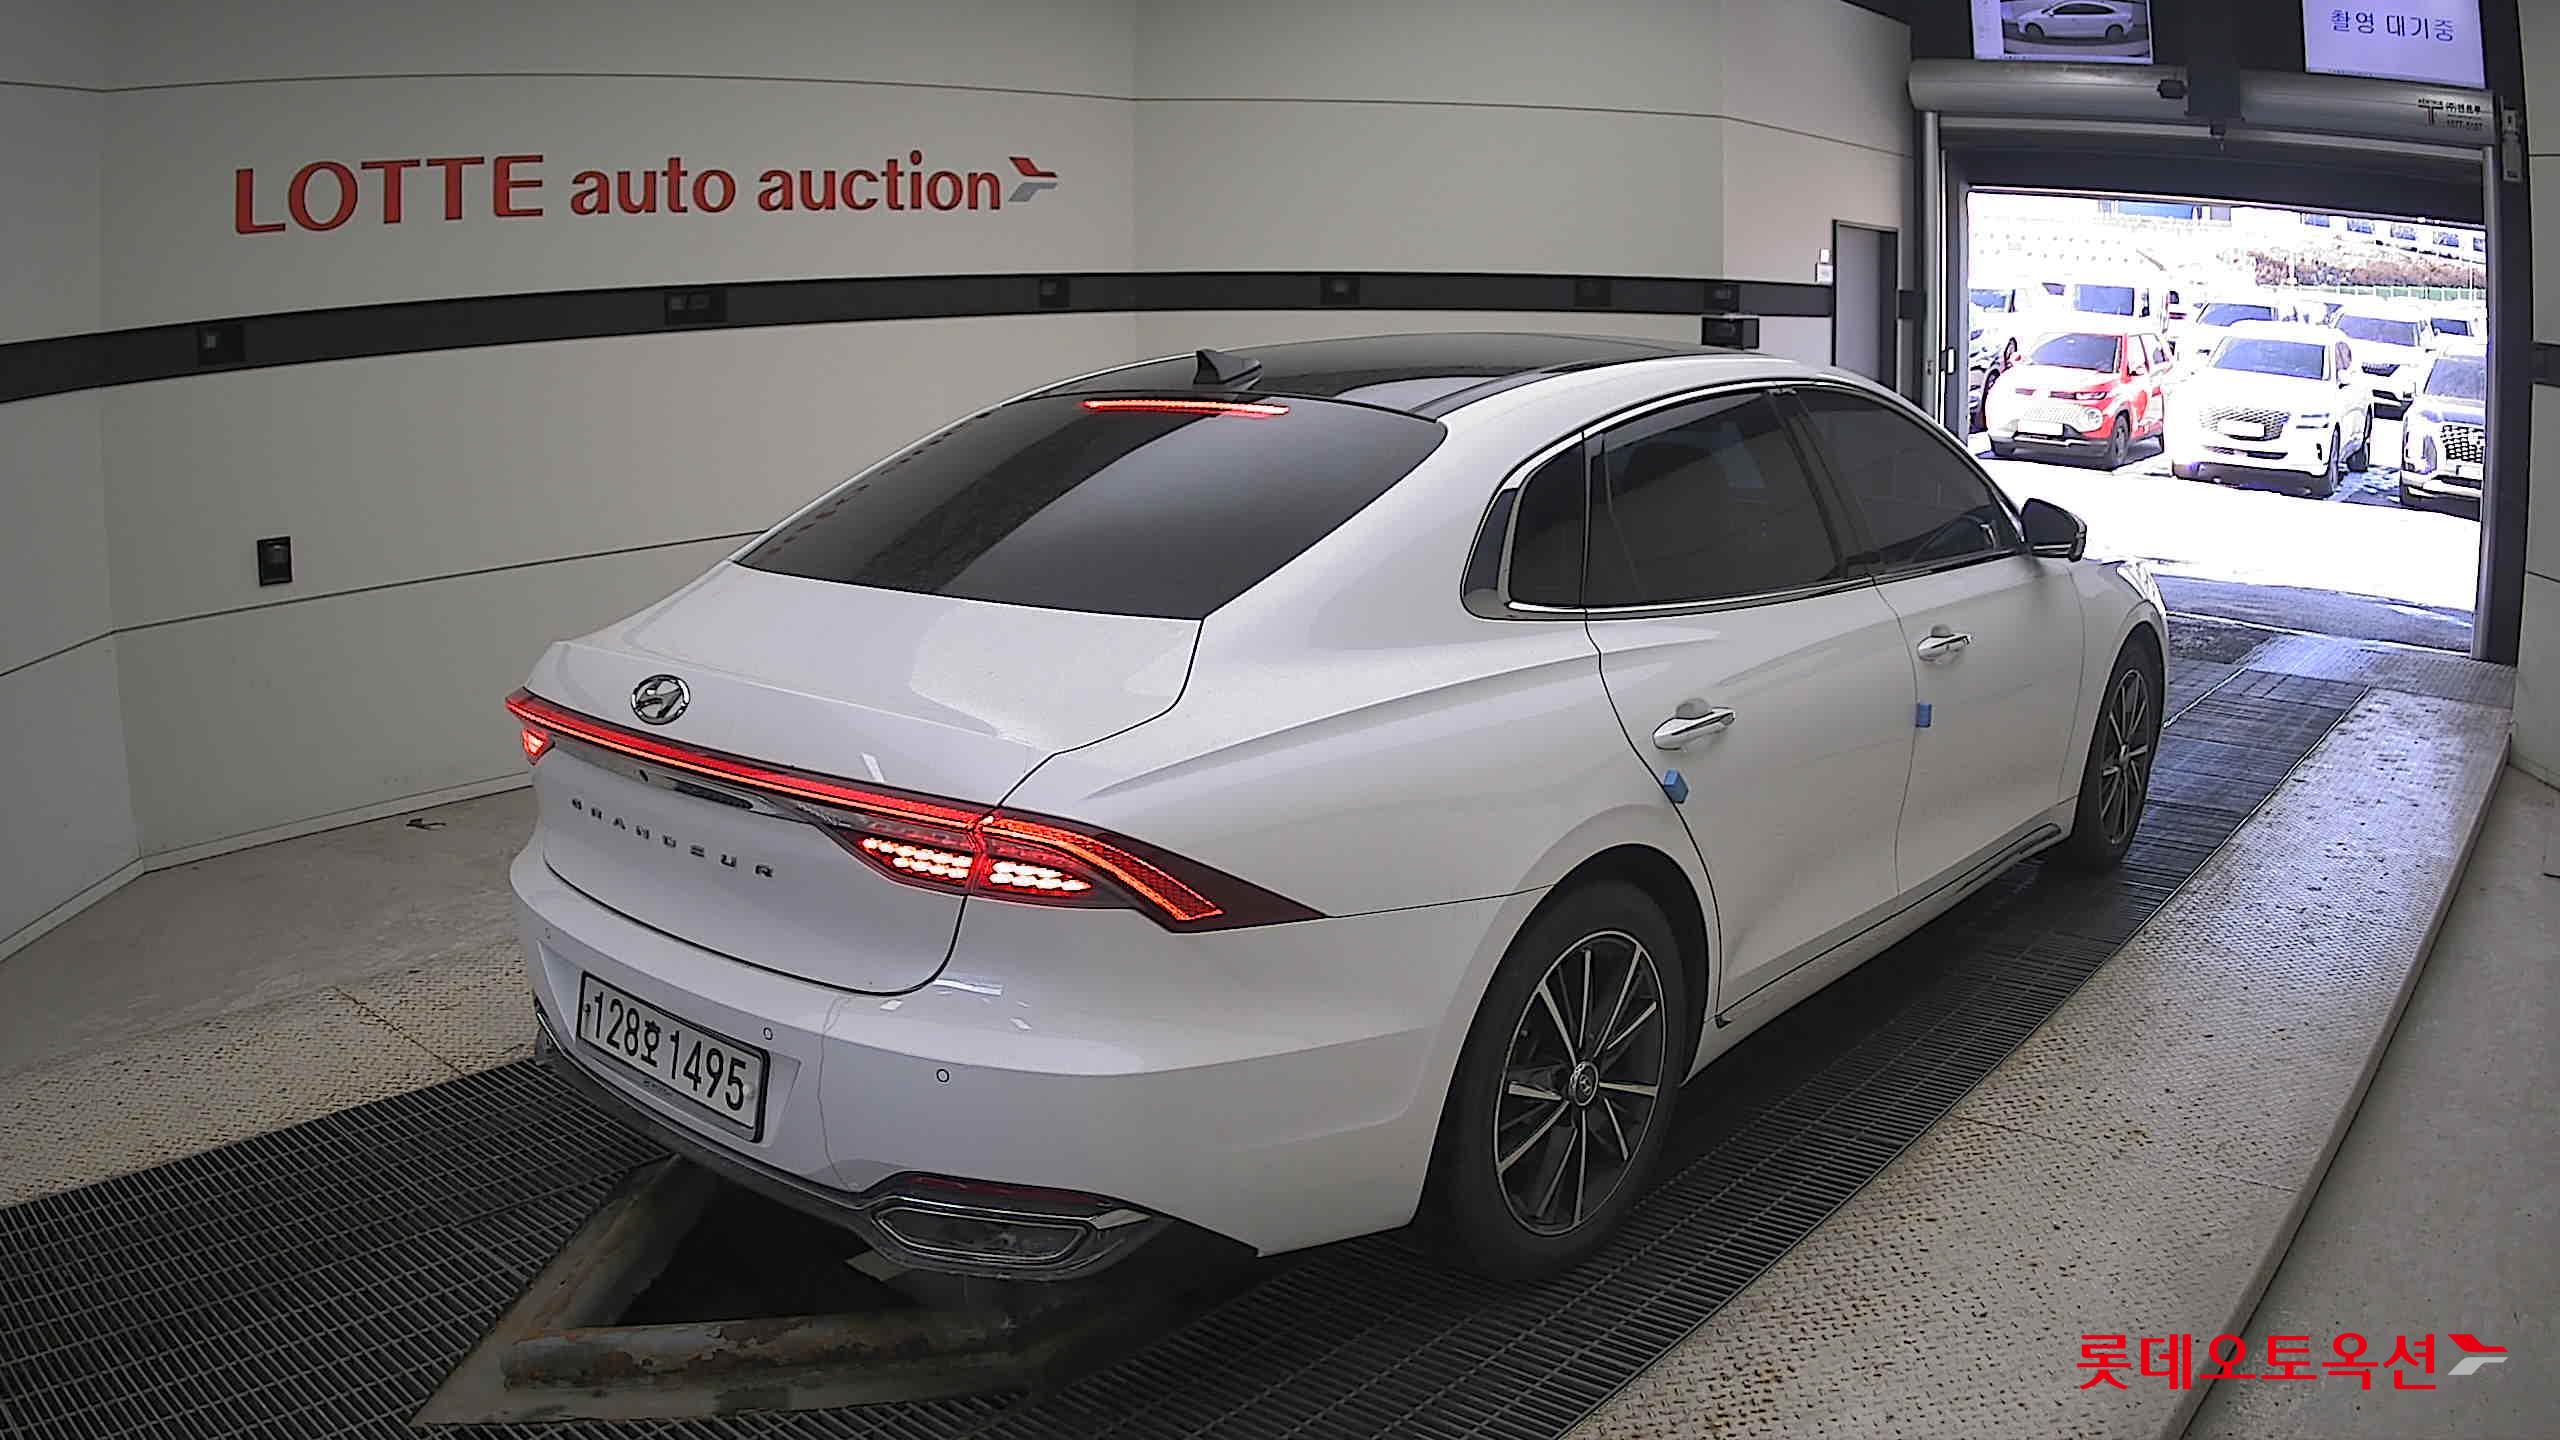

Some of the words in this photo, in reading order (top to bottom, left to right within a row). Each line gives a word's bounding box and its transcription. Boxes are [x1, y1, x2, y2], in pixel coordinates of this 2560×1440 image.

[2331, 9, 2376, 34] 촬영
[2386, 15, 2454, 42] 대기중
[235, 154, 544, 235] LOTTE
[570, 156, 736, 216] auto
[757, 149, 1002, 211] auction
